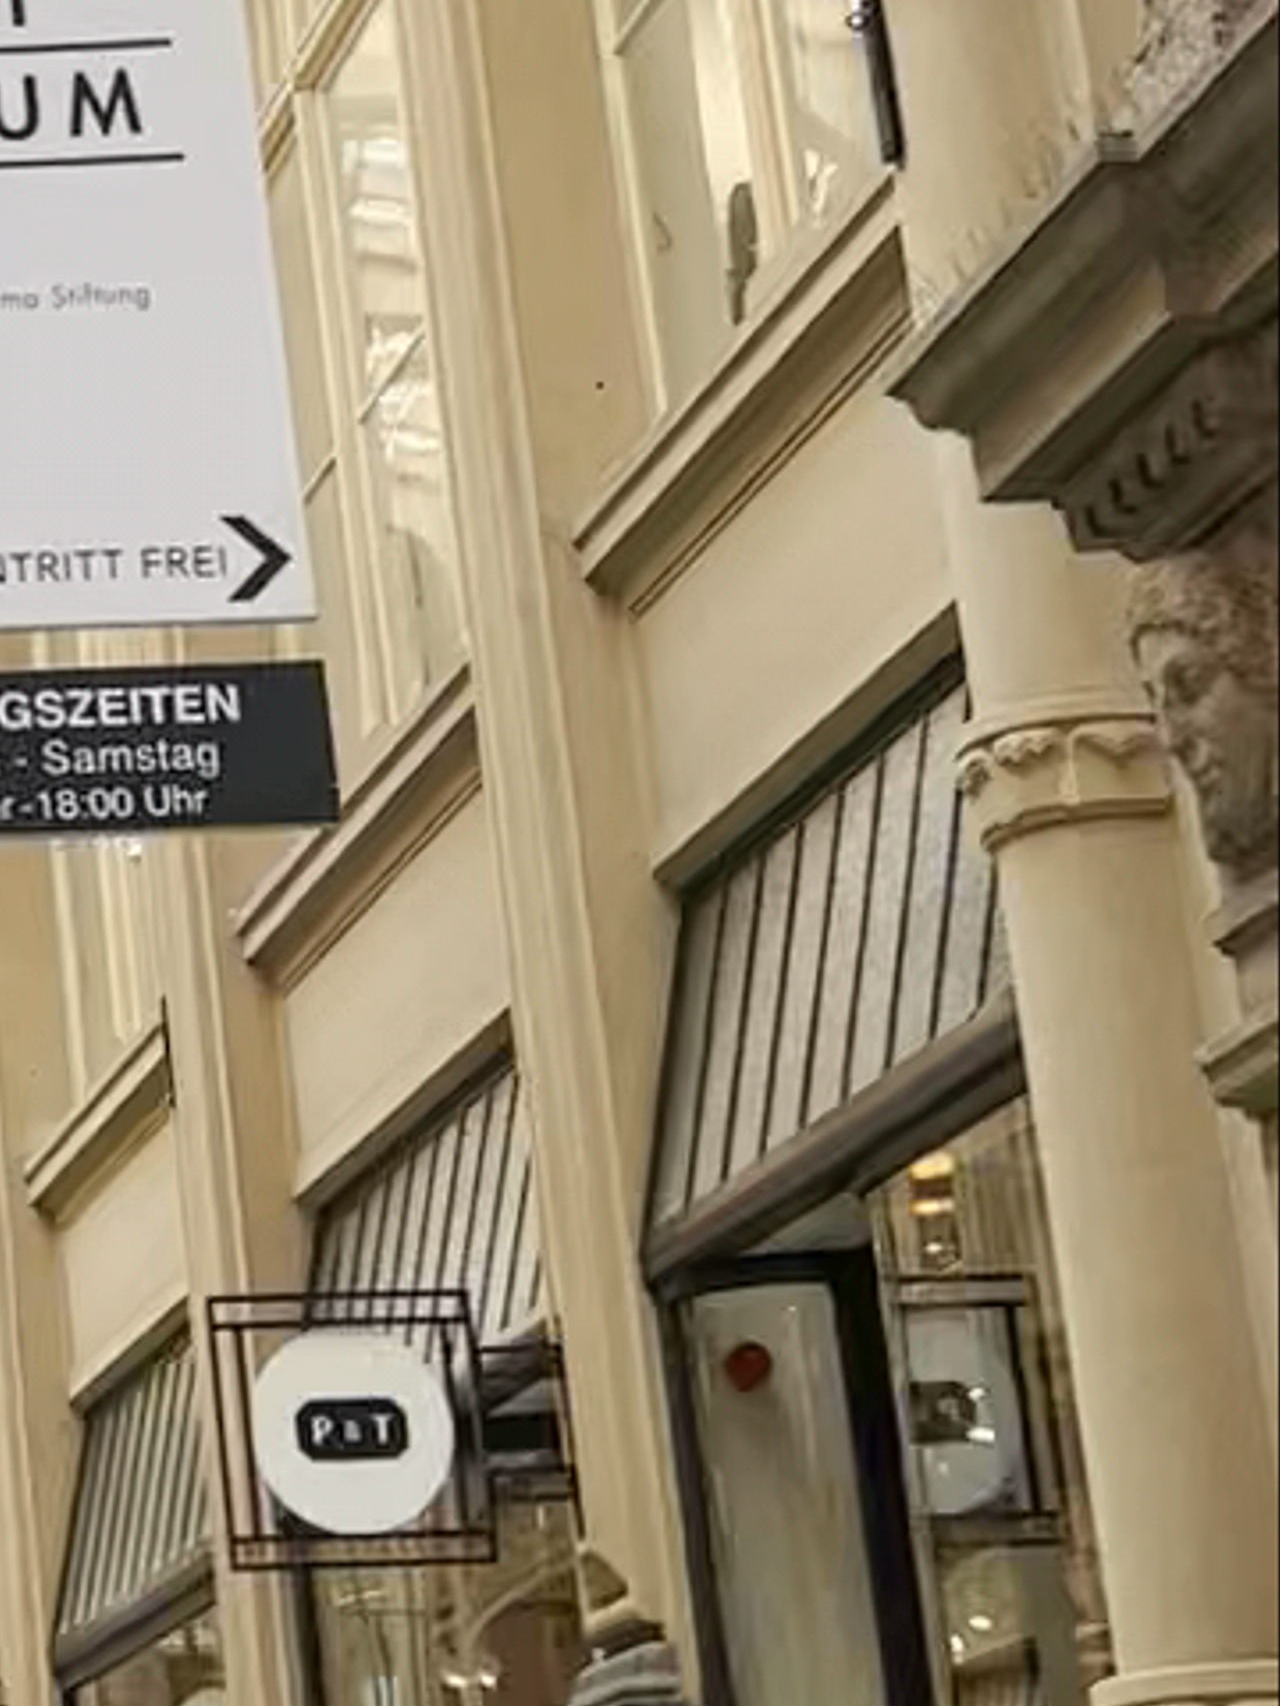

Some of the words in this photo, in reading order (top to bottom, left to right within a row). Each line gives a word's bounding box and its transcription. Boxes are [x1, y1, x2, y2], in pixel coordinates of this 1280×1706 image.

[50, 282, 152, 312] Stiftung
[141, 546, 226, 577] FREI
[43, 739, 219, 777] Samstag
[144, 785, 206, 816] Uhr
